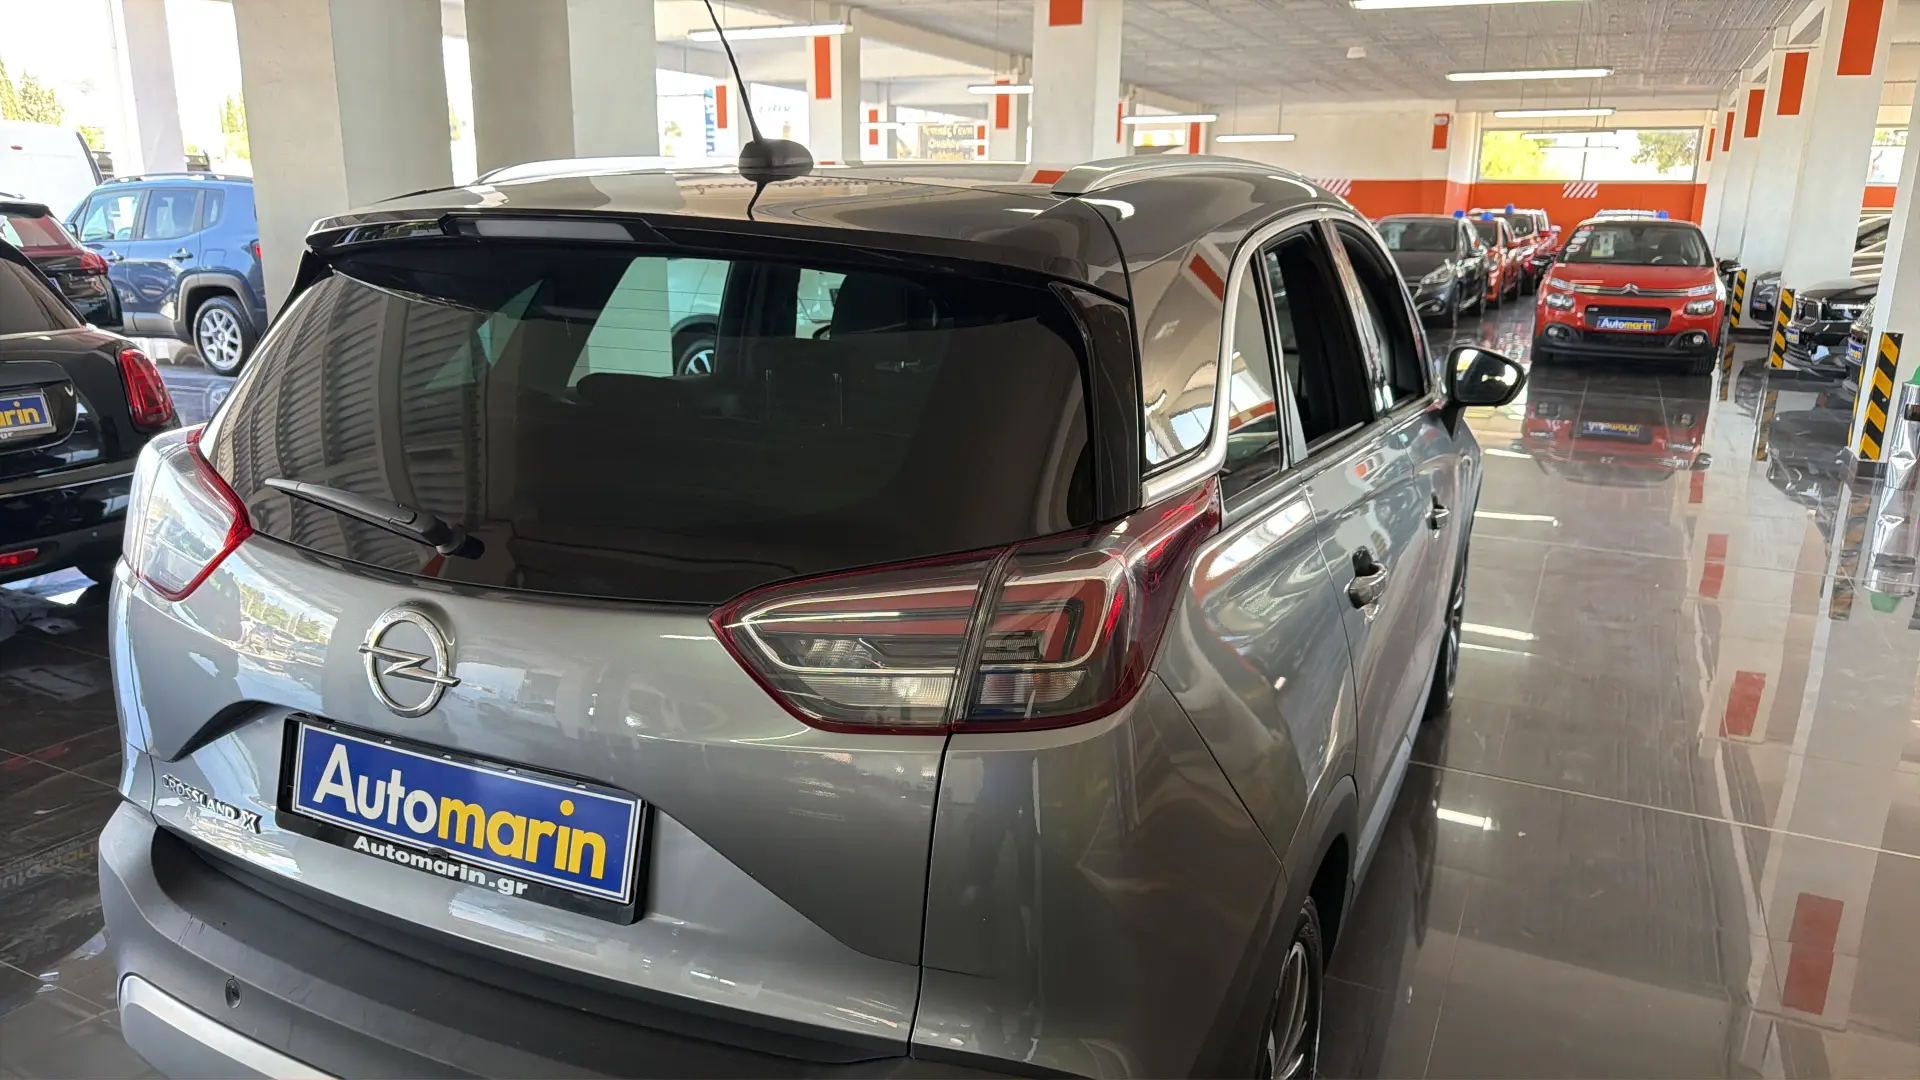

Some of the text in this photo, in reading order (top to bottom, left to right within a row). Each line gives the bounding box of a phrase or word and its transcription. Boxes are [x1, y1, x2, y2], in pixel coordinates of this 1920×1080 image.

[1601, 318, 1652, 330] Automarin
[161, 774, 240, 820] CROSSLAND
[241, 809, 262, 834] X
[312, 743, 607, 880] Automarin
[353, 836, 528, 896] Automarin.gr
